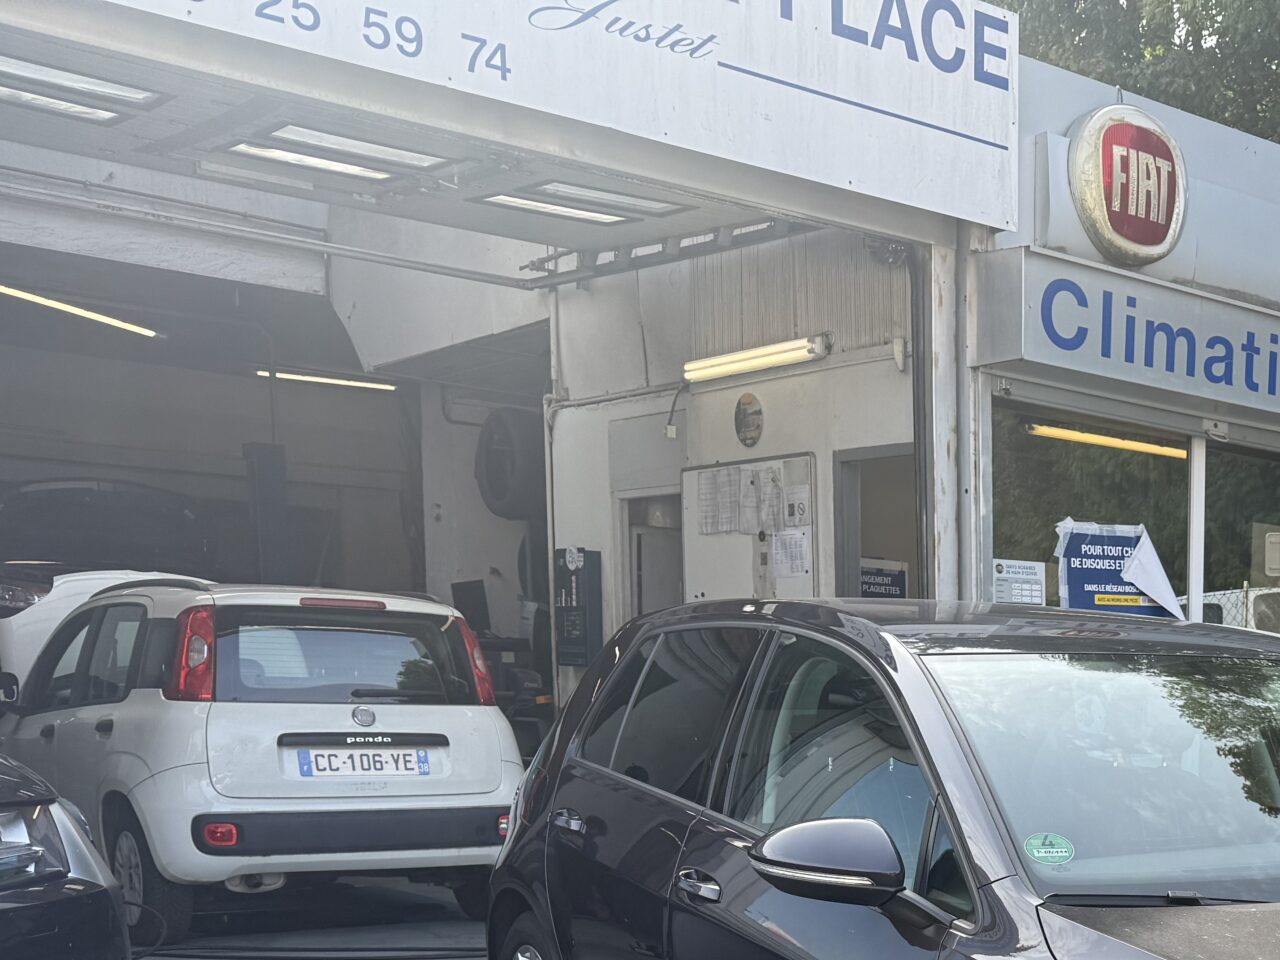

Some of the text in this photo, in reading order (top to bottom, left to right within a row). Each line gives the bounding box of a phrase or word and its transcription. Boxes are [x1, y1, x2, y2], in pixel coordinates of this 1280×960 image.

[362, 7, 423, 58] 59
[460, 33, 512, 81] 74
[1112, 144, 1172, 225] FIAT
[1081, 544, 1103, 556] POUR
[1103, 545, 1123, 556] TOUT
[1070, 557, 1081, 568] DE
[1082, 558, 1115, 570] DISQUES
[863, 585, 900, 594] PLAQUETTES
[1084, 584, 1099, 592] DANS
[314, 753, 415, 772] CC-106-YE
